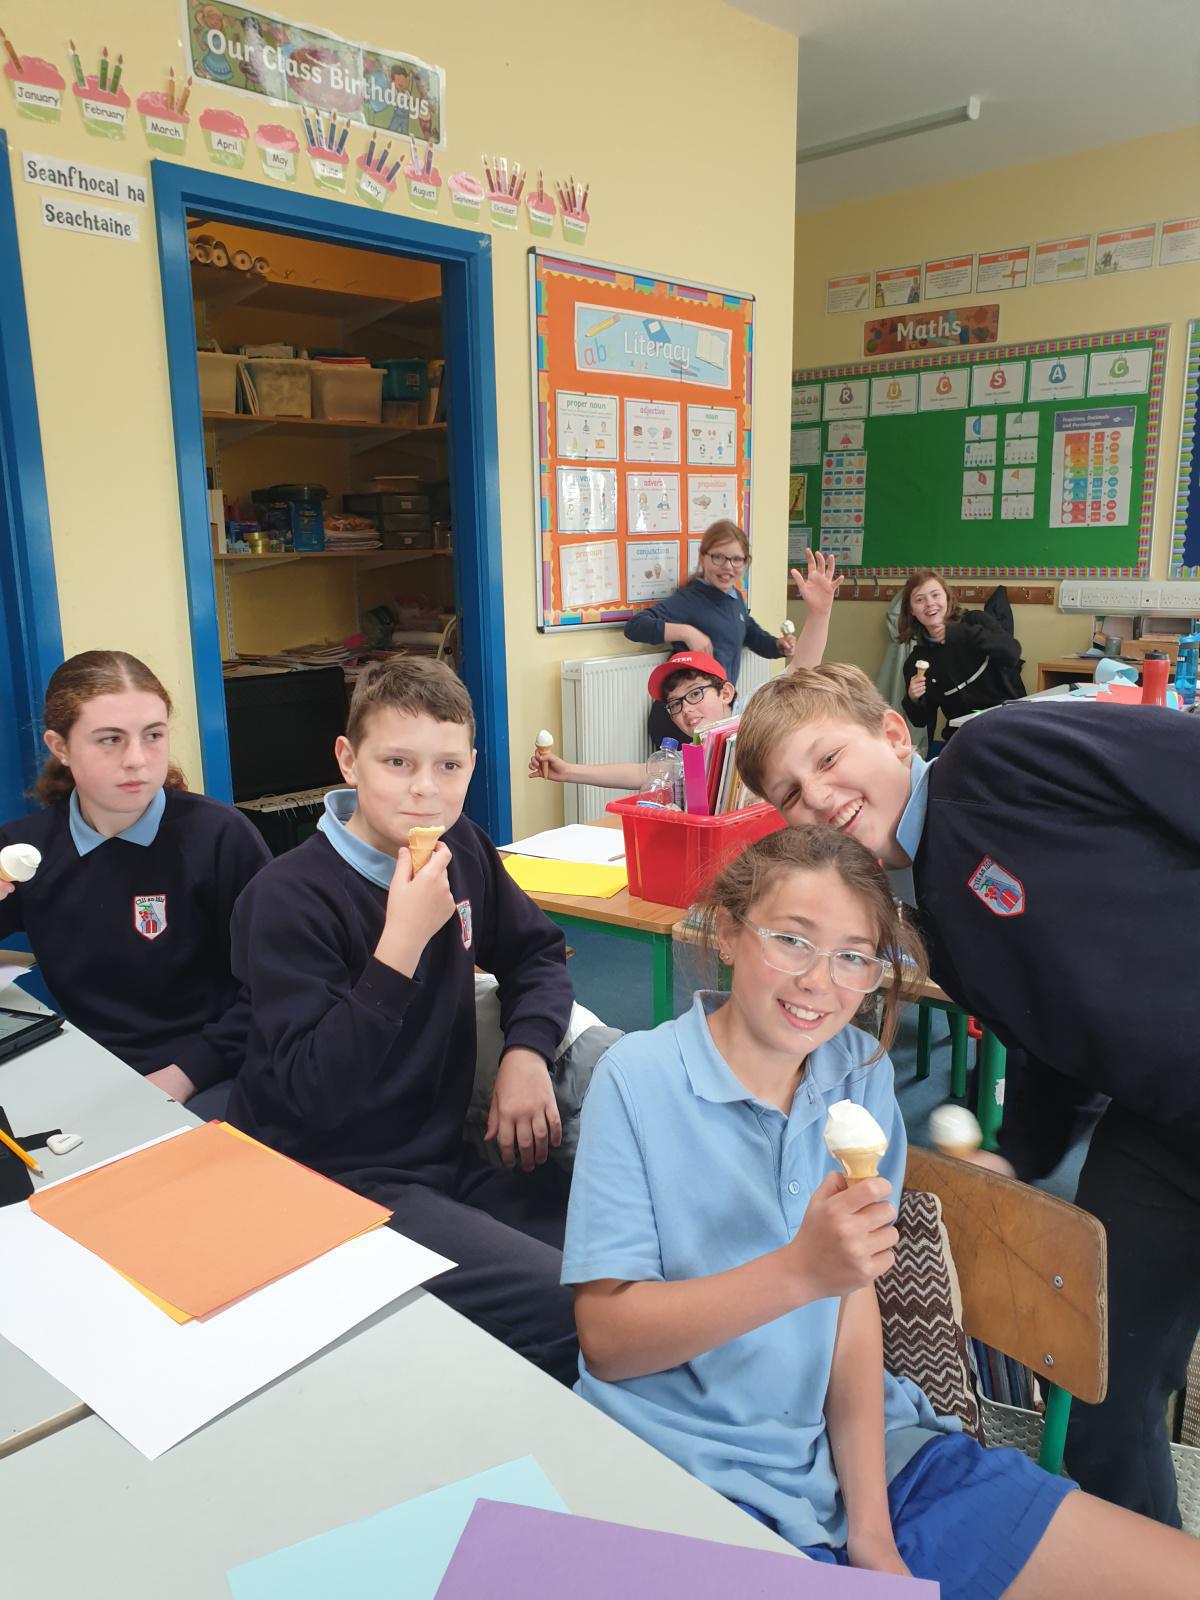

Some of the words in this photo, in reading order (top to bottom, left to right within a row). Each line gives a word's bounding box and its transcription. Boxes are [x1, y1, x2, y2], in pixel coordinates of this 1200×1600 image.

[206, 29, 257, 62] Our
[263, 46, 322, 83] Class
[330, 66, 429, 119] Birthdays
[17, 86, 59, 106] January
[84, 103, 125, 122] February
[151, 122, 181, 137] March
[217, 138, 238, 151] April
[272, 153, 289, 166] May
[27, 160, 119, 197] Seanfhocal
[127, 184, 145, 202] na
[413, 185, 435, 198] August
[45, 203, 131, 237] Seachtaine
[896, 315, 962, 342] Maths
[624, 331, 690, 369] Literacy
[1052, 366, 1064, 380] A
[1113, 360, 1125, 374] C
[939, 379, 948, 392] C
[994, 372, 1003, 385] S
[842, 390, 850, 401] R
[566, 400, 588, 409] proper
